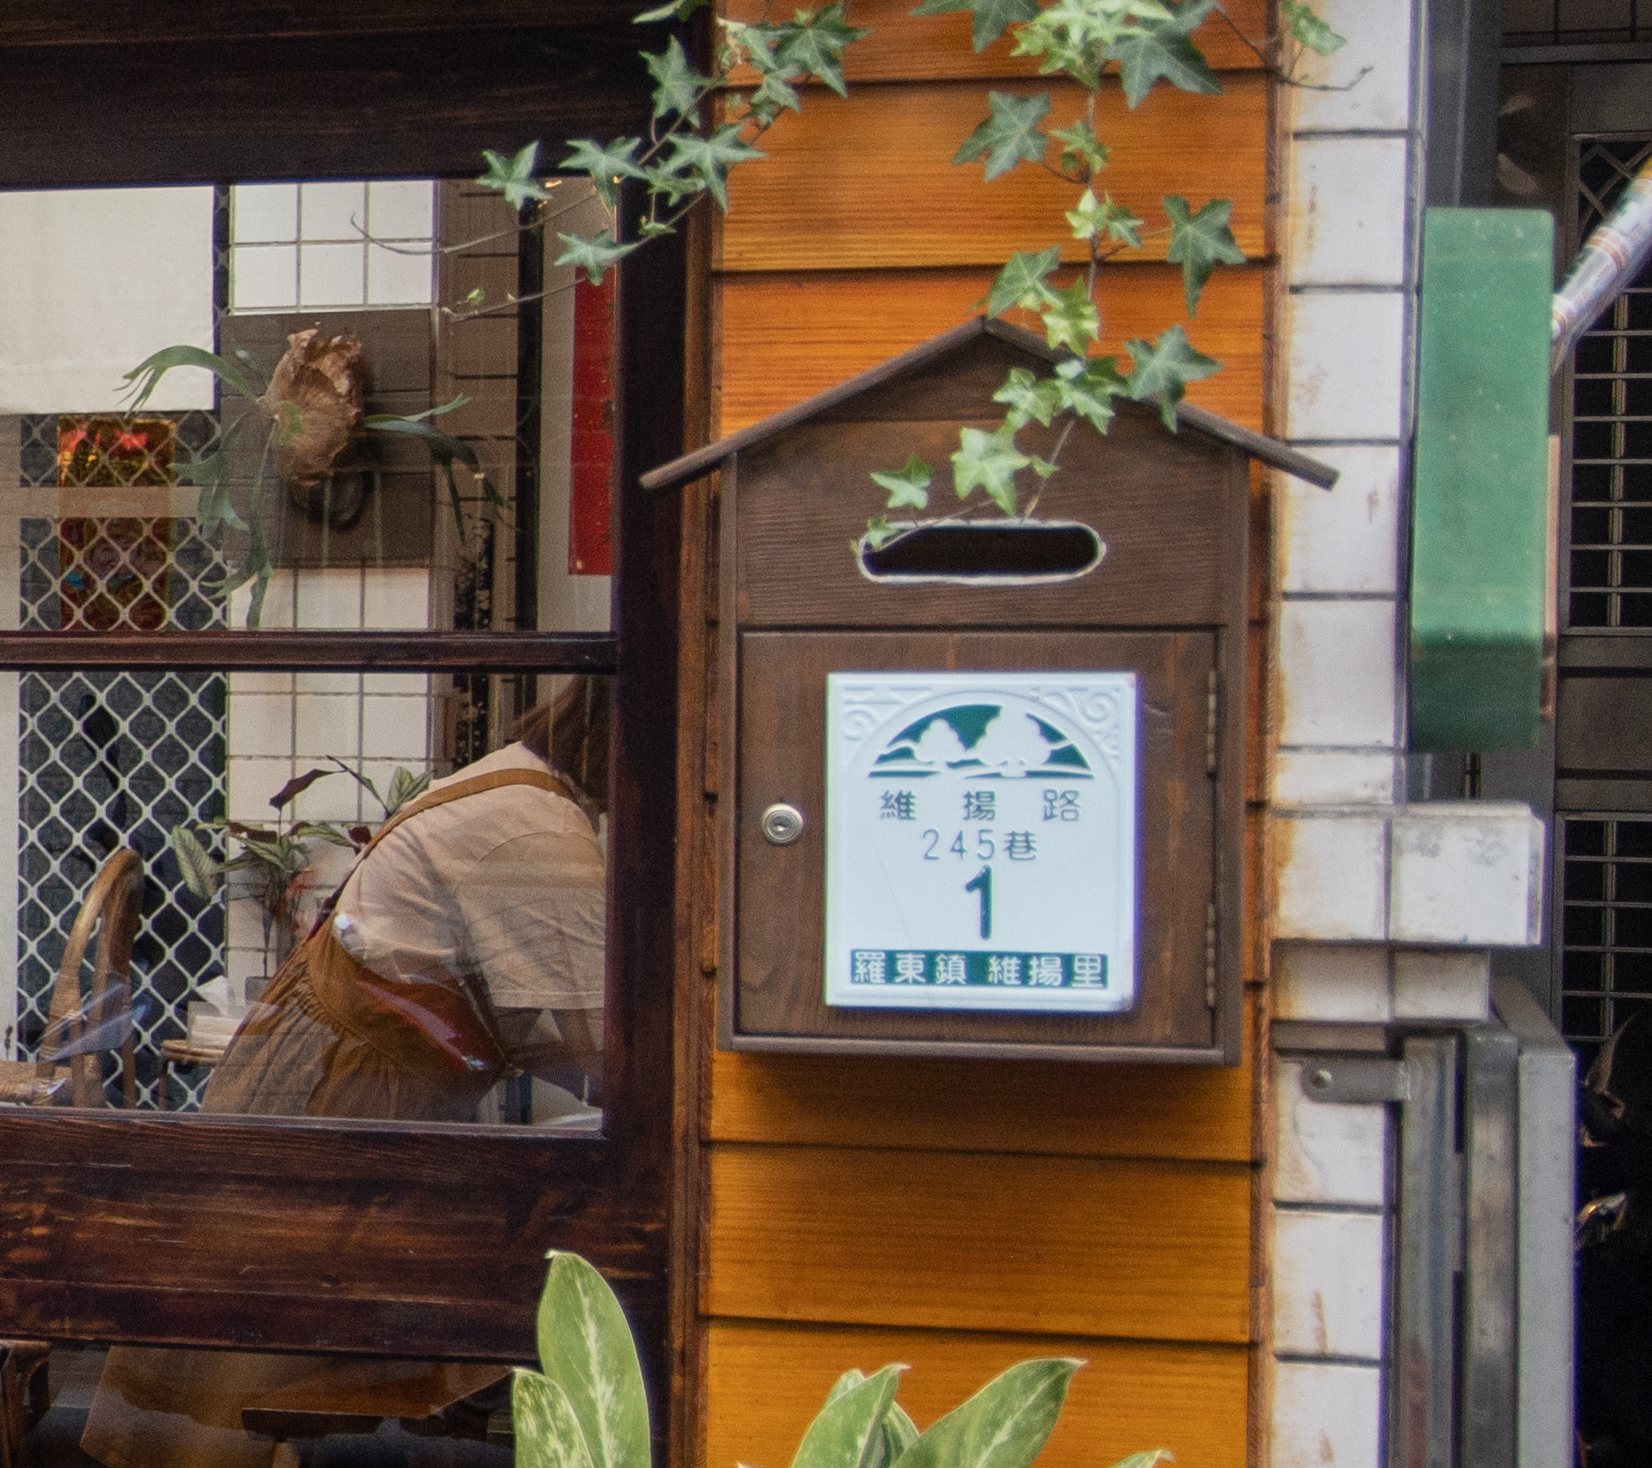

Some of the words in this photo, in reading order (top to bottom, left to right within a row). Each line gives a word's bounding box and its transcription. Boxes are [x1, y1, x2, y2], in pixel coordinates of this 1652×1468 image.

[880, 789, 1082, 822] 維揚路
[922, 828, 1038, 862] 245巷
[964, 863, 993, 941] 1
